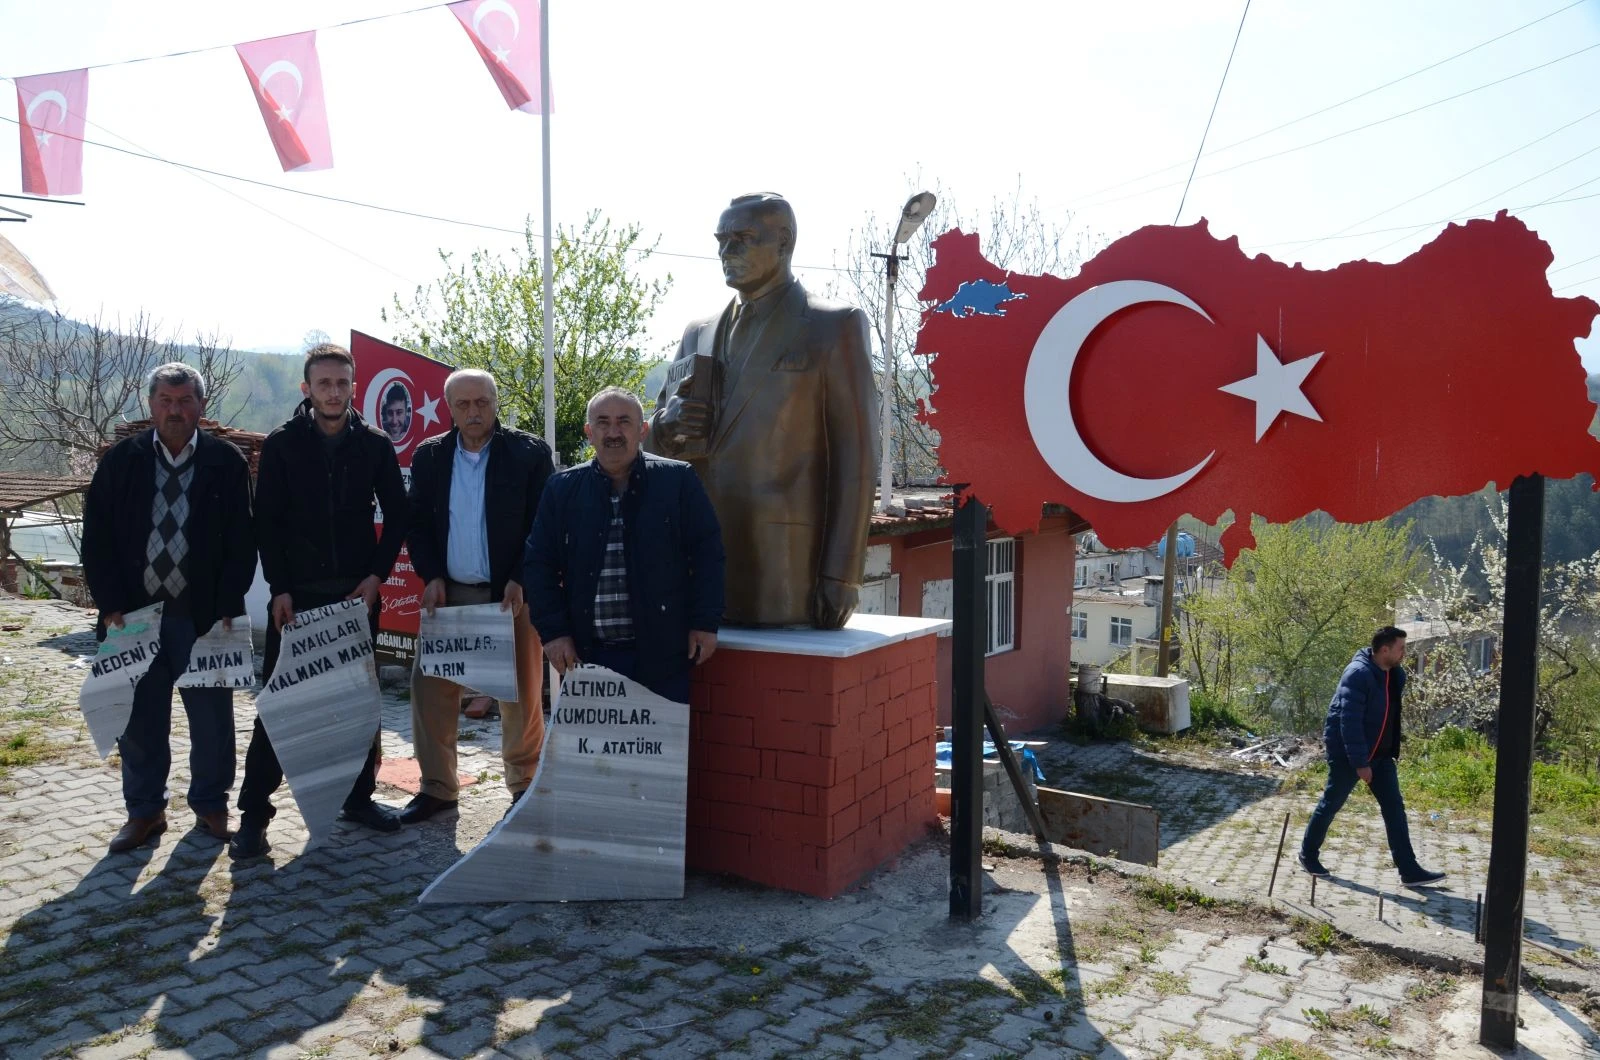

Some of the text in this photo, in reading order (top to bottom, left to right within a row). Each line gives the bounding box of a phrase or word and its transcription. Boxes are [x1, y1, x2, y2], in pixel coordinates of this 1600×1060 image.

[291, 618, 361, 657] AYAKLARI
[91, 641, 147, 678] MEDENİ
[268, 639, 373, 694] KALMAYA MAH
[560, 681, 627, 697] ALTINDA
[578, 737, 662, 754] K. ATATÜRK
